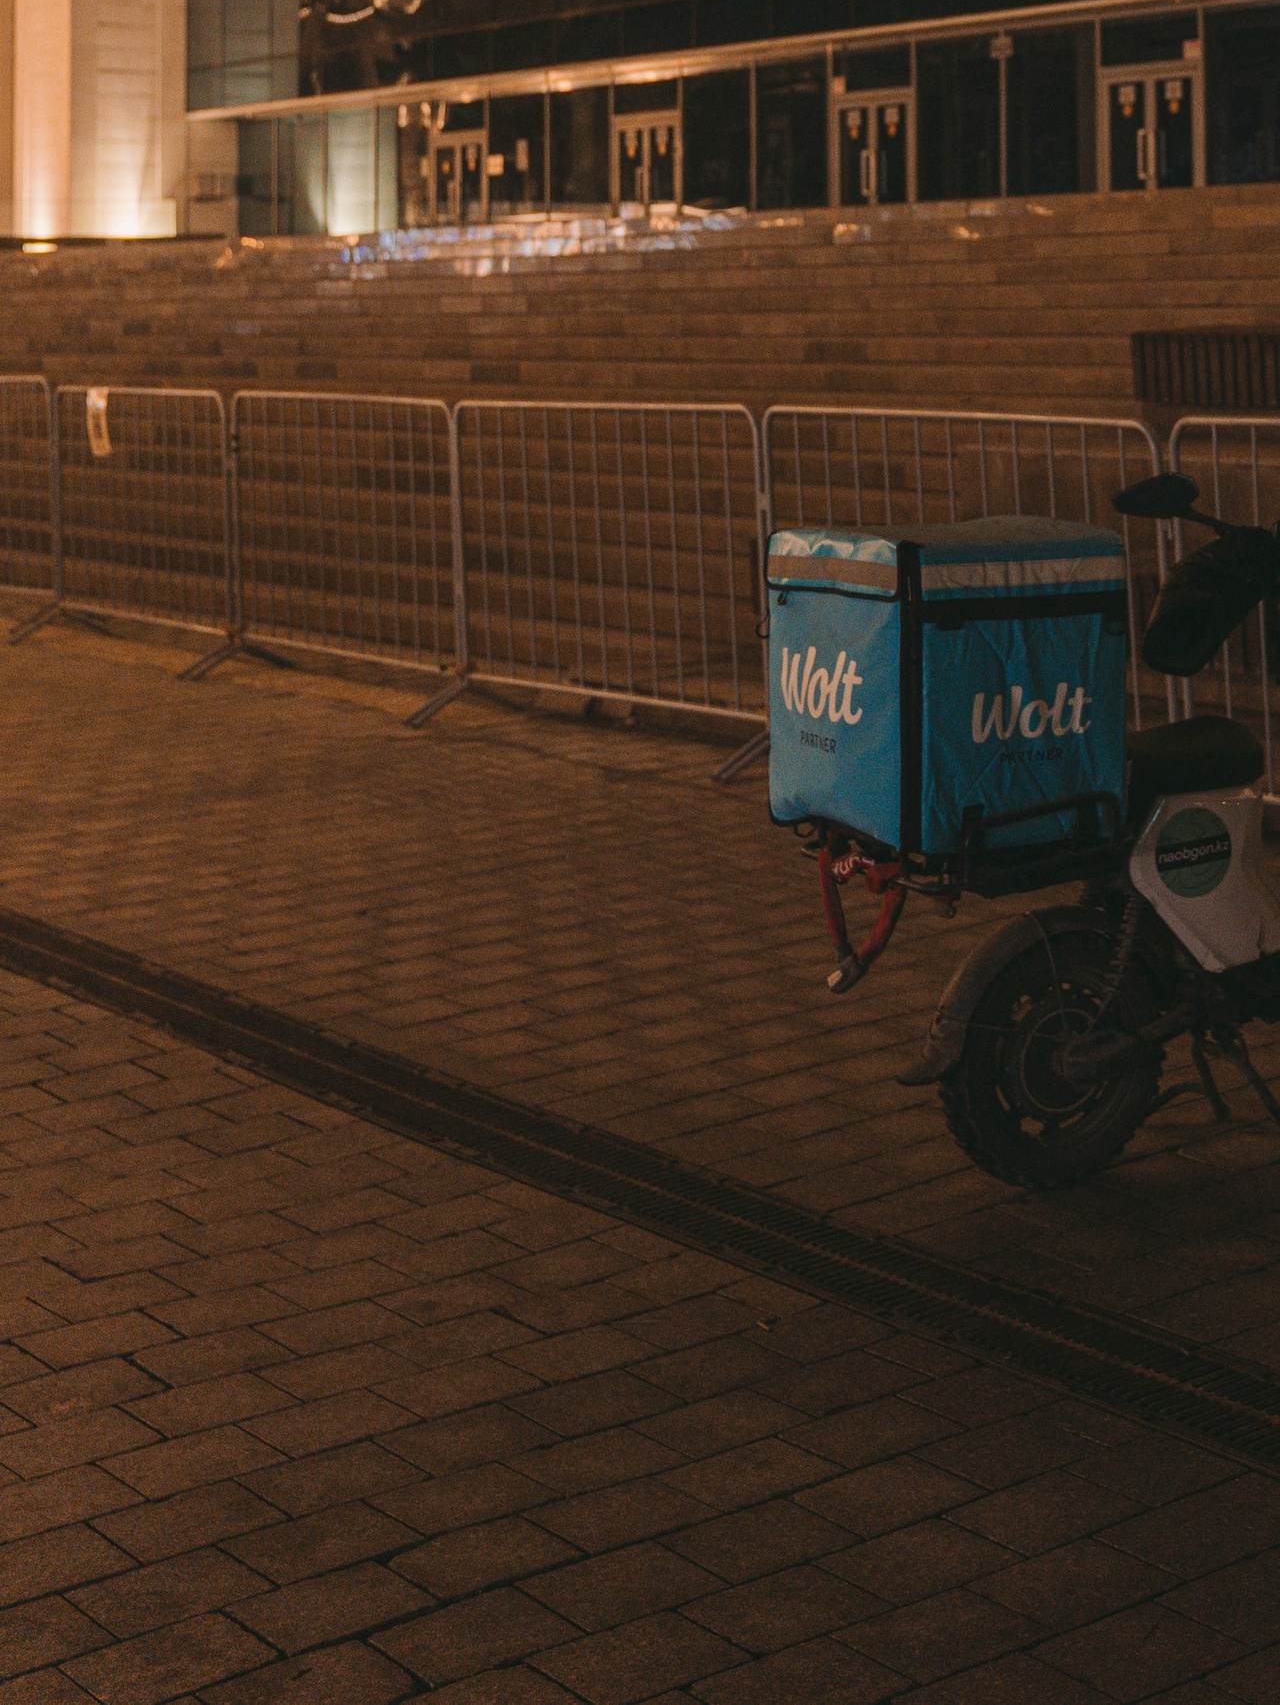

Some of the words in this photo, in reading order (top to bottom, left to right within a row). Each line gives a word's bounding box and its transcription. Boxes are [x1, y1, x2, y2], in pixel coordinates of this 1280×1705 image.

[781, 646, 863, 725] Wolt
[972, 682, 1092, 744] Wolt
[801, 730, 837, 754] PARTNER
